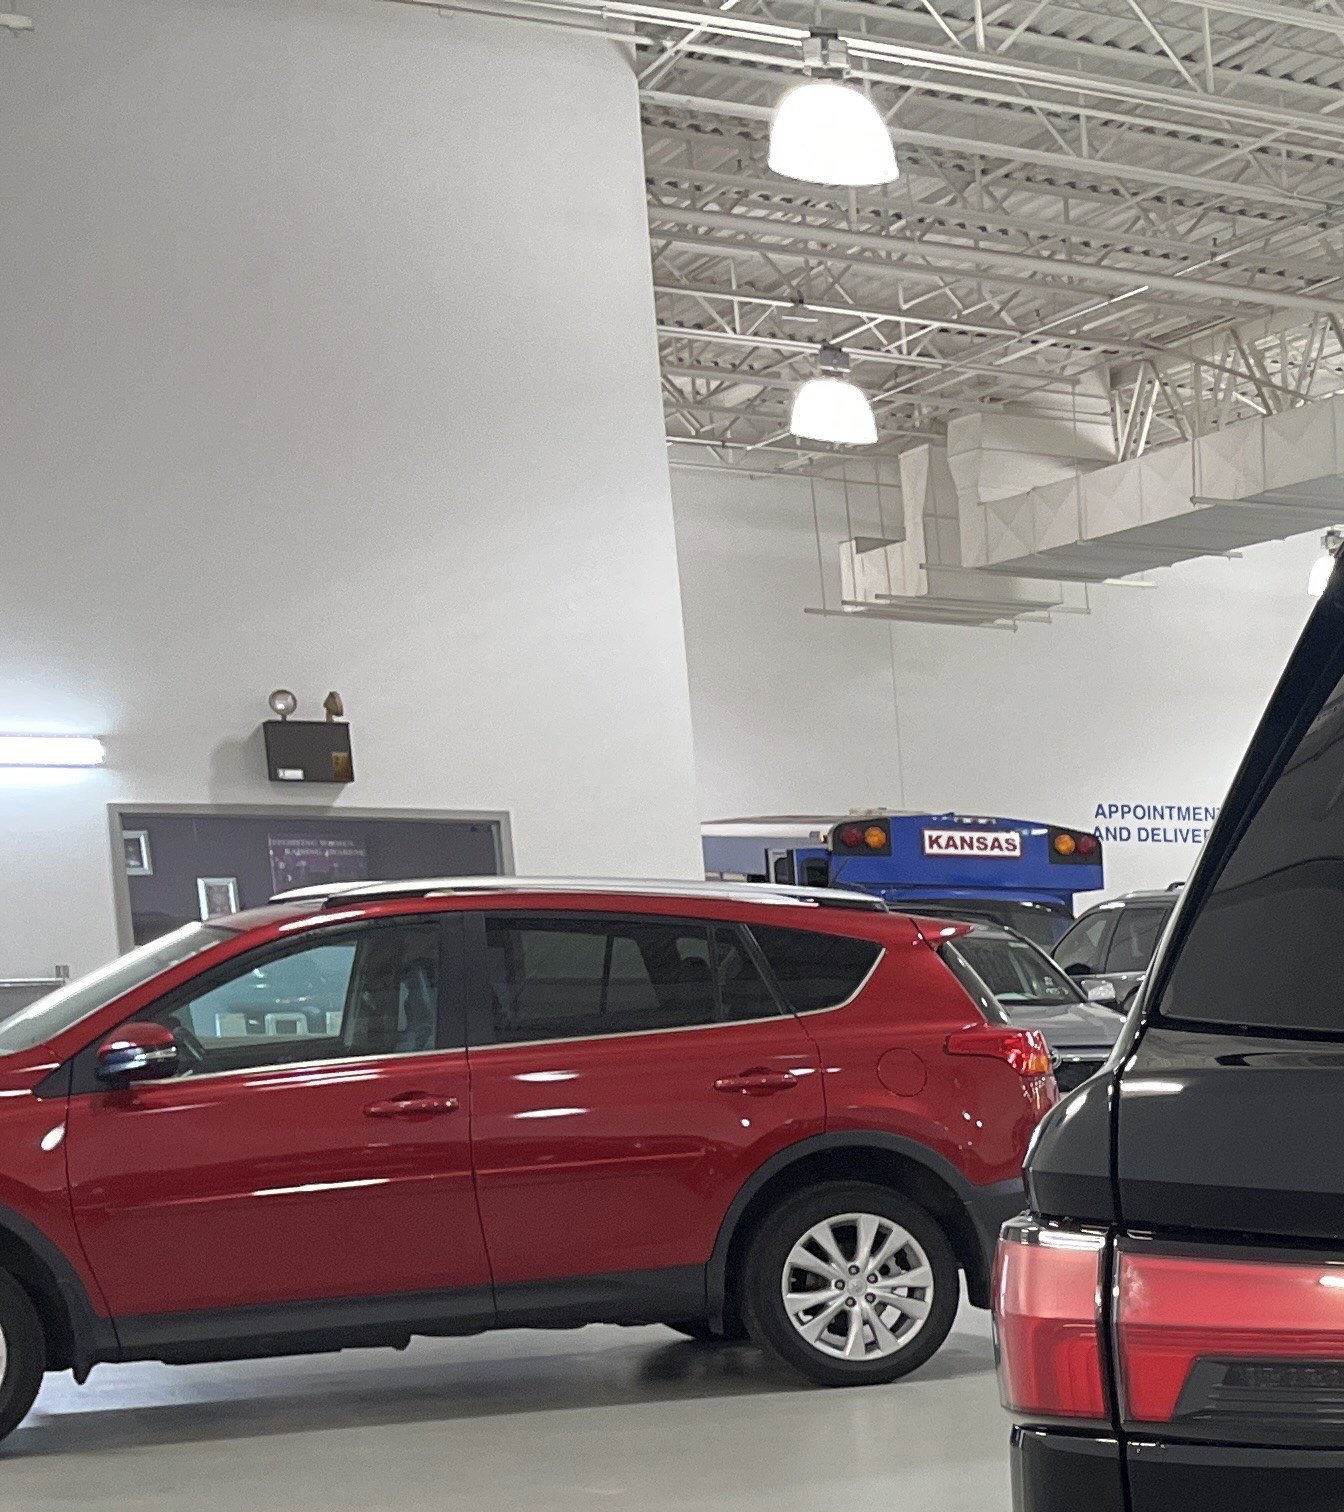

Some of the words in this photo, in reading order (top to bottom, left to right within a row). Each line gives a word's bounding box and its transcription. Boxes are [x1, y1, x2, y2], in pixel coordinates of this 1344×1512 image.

[1094, 803, 1220, 821] APPOINTMEN
[1093, 825, 1131, 842] AND
[927, 834, 1018, 852] KANSAS
